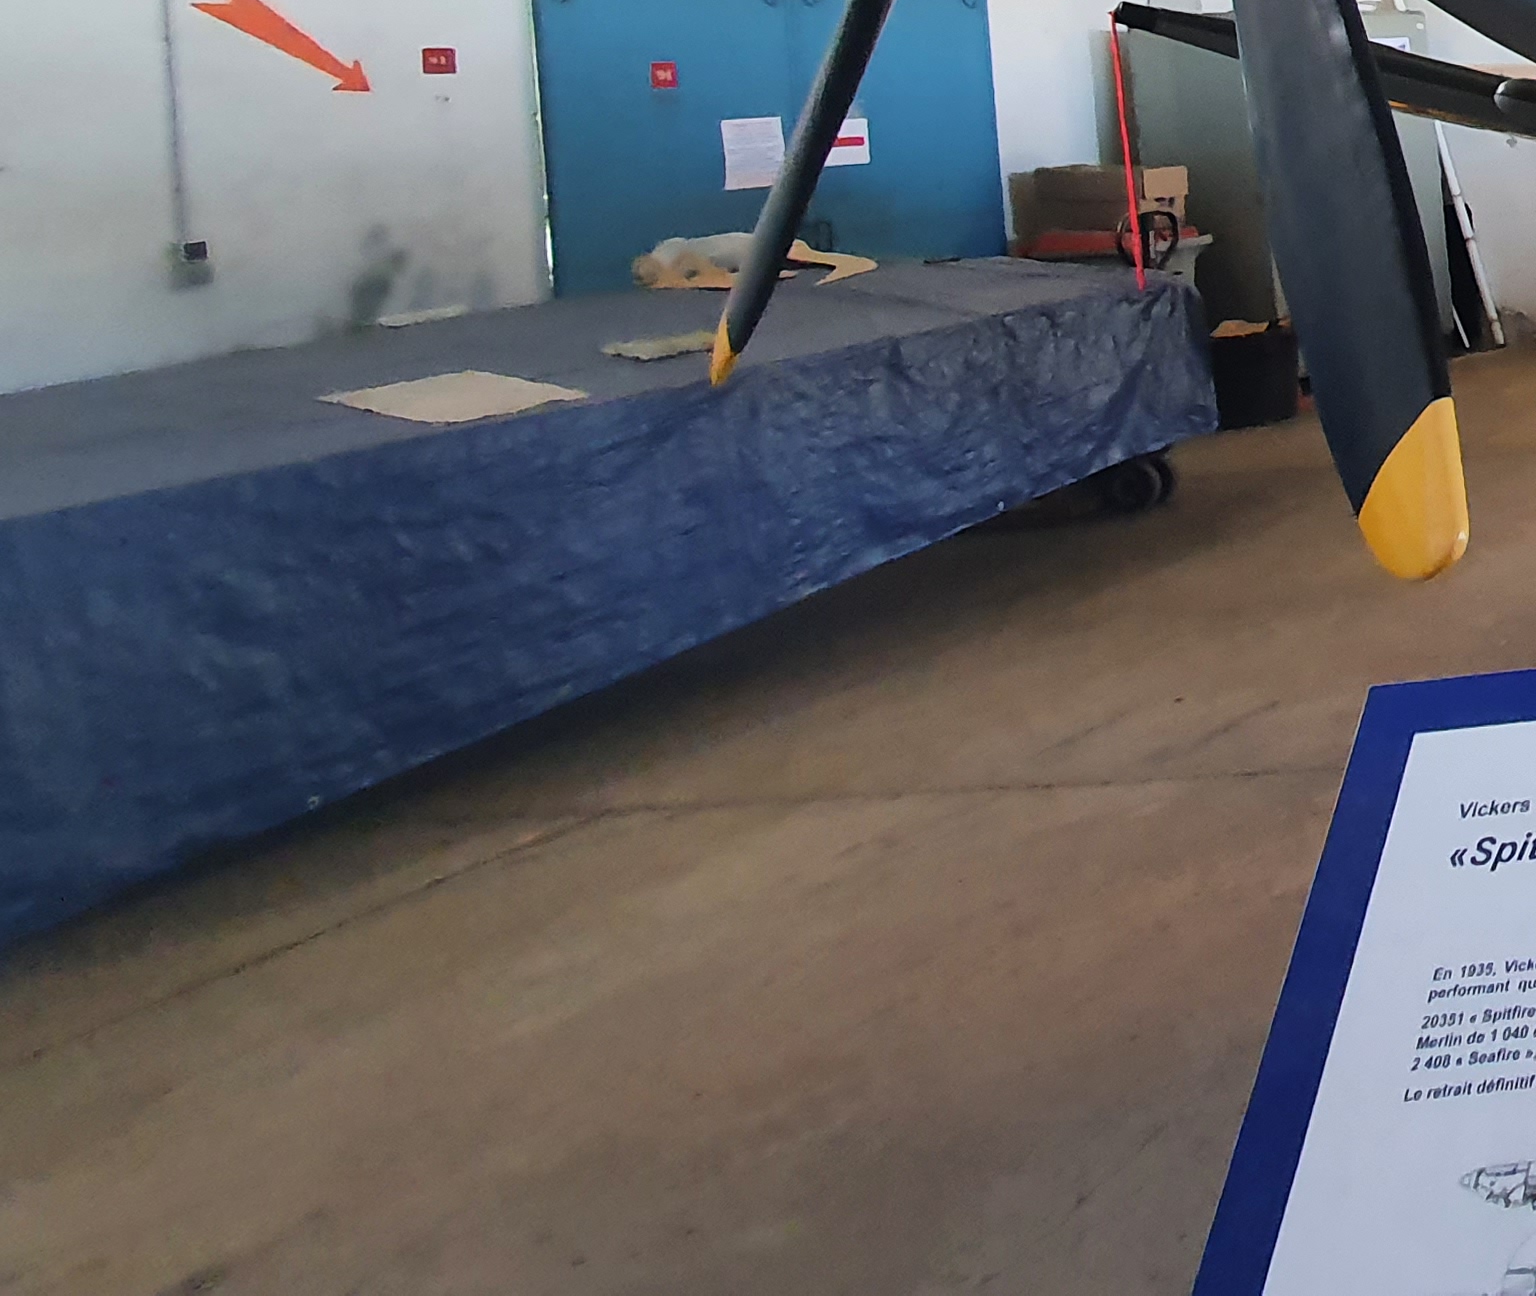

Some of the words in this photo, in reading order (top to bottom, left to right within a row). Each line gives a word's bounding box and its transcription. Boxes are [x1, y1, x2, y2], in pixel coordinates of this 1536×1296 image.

[1459, 798, 1531, 819] Vickers
[1432, 967, 1452, 982] En
[1428, 980, 1510, 1003] performant
[1482, 1005, 1536, 1024] Spitfire
[1416, 1031, 1462, 1050] Merlin
[1466, 1030, 1485, 1045] de
[1411, 1057, 1421, 1071] 2
[1468, 1048, 1520, 1066] Seafire
[1404, 1089, 1422, 1103] Le
[1426, 1082, 1472, 1099] retrait
[1476, 1074, 1536, 1095] définitif
